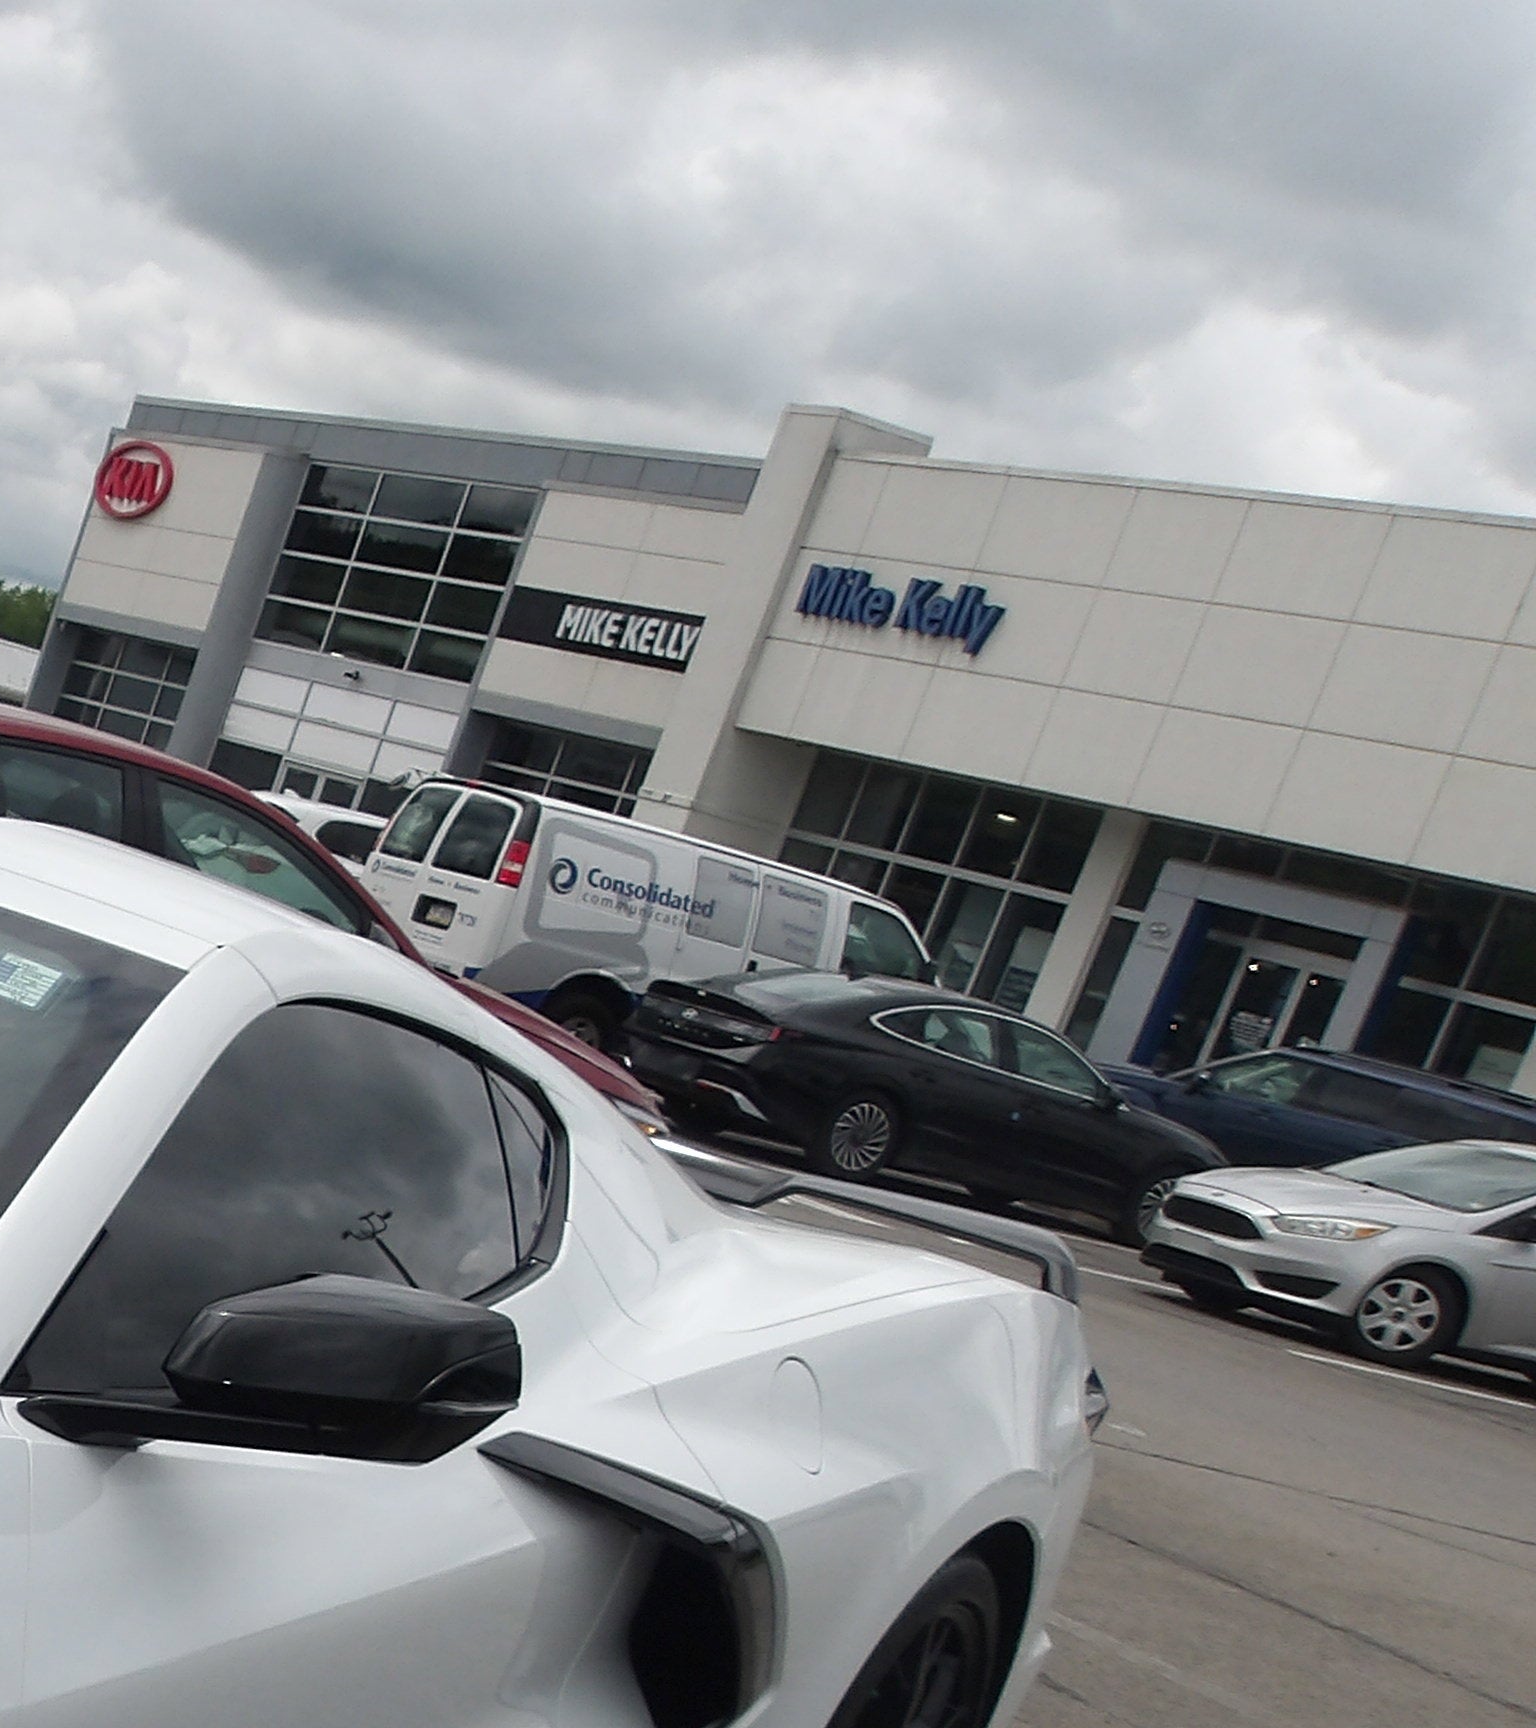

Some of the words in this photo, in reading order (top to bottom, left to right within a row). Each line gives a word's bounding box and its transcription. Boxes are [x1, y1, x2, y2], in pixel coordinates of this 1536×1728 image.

[554, 603, 625, 649] MIKE
[618, 615, 702, 662] KELLY
[795, 563, 897, 628] Mike
[892, 577, 1007, 658] Kelly
[586, 867, 715, 919] Consolidated
